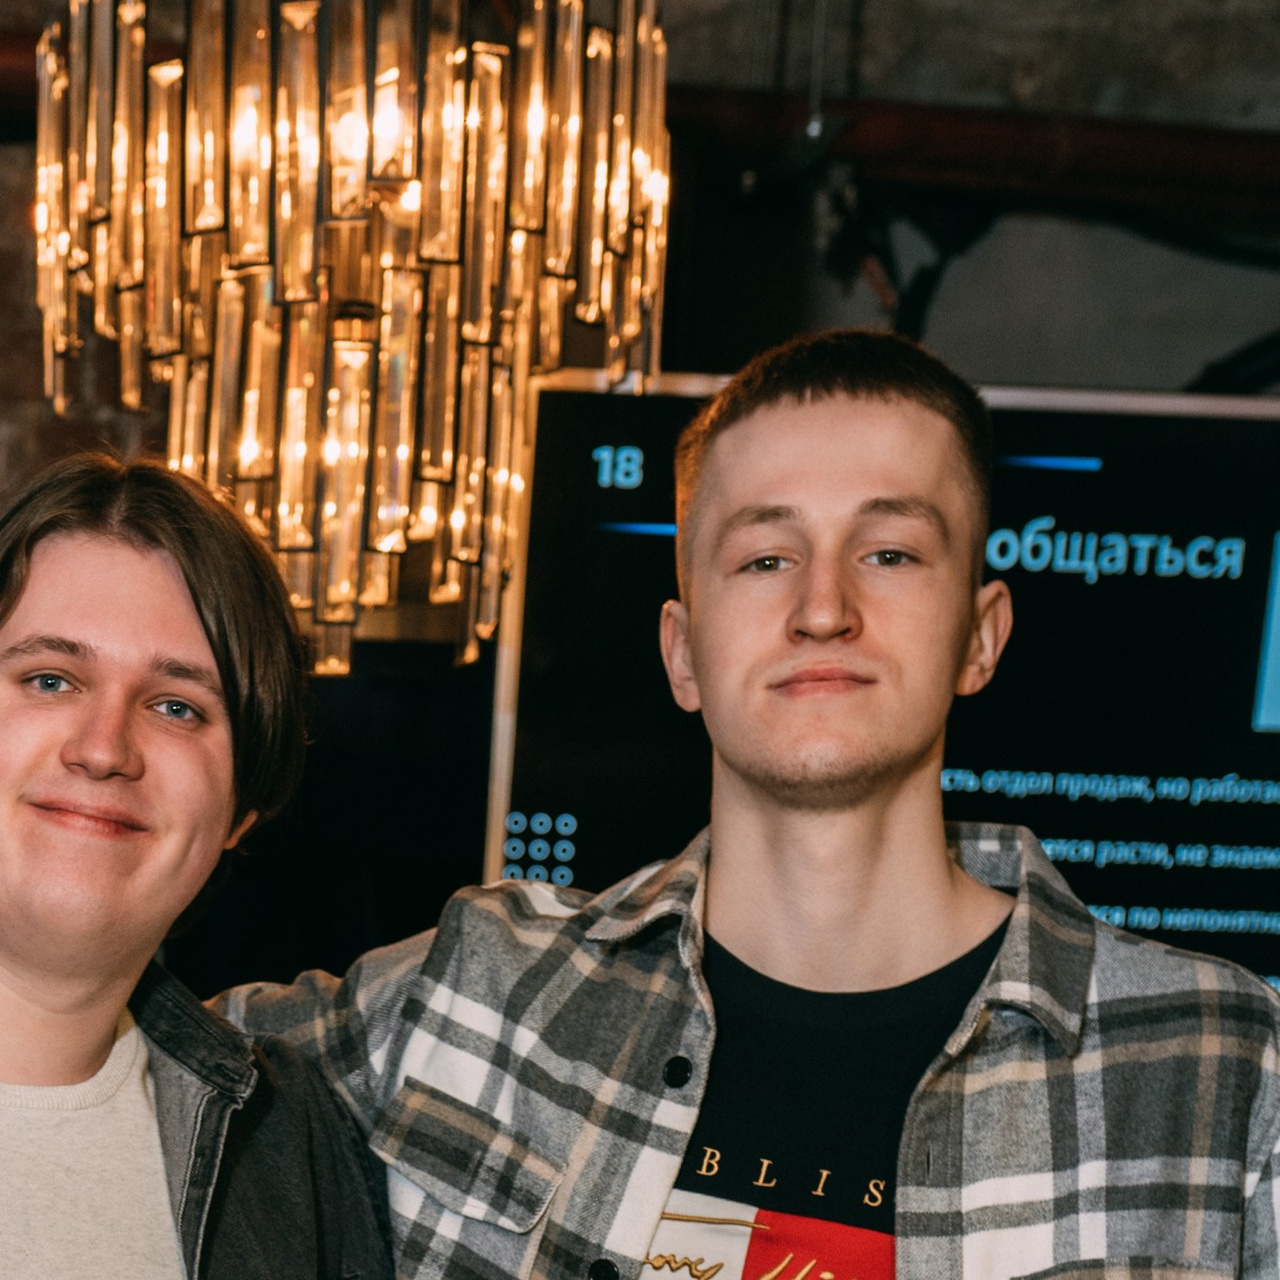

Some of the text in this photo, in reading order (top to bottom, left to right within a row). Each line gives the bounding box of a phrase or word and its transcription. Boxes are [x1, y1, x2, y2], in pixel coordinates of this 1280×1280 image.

[591, 445, 644, 490] 18
[985, 515, 1246, 585] общаться
[1156, 776, 1190, 801] но
[1175, 844, 1209, 867] не
[1127, 906, 1161, 931] по
[696, 1146, 886, 1208] BLIS
